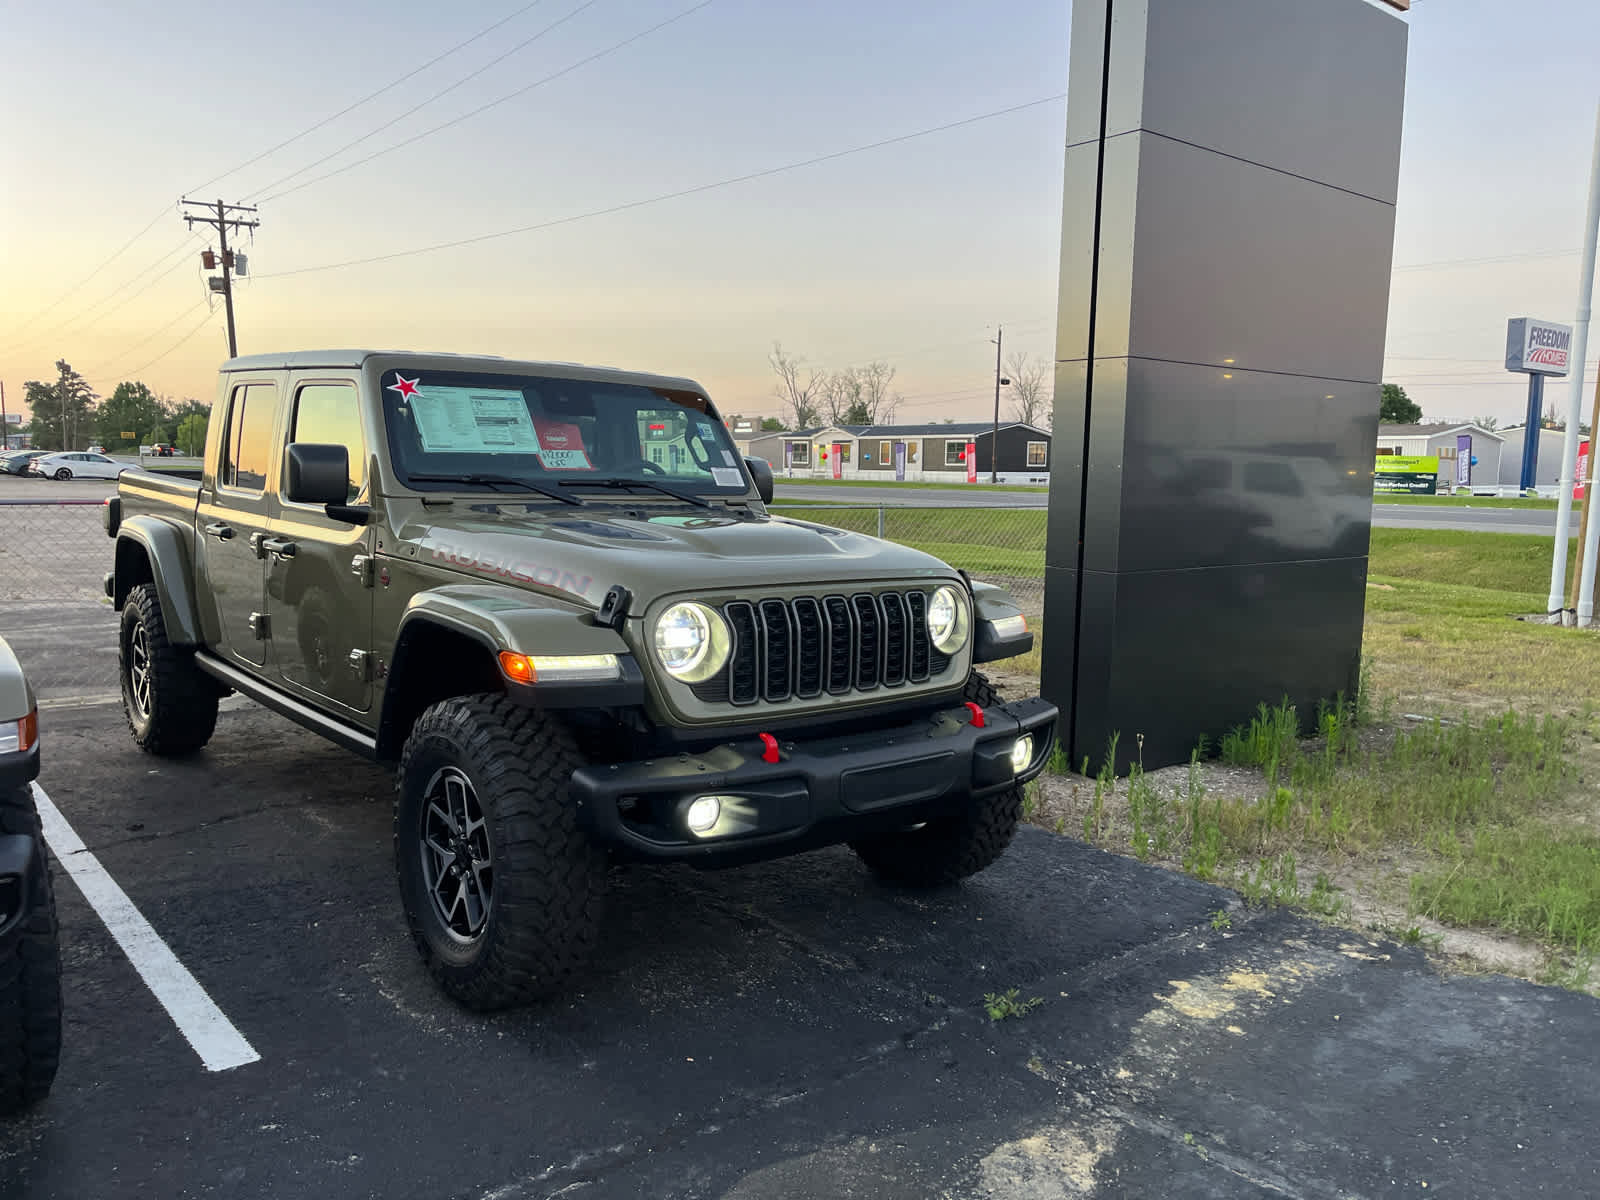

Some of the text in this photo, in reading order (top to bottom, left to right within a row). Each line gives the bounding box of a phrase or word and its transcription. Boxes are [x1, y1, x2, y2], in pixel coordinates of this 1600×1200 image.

[1528, 326, 1570, 350] FREEDOM
[1542, 349, 1567, 364] HOMES
[431, 543, 592, 595] RUBICON
